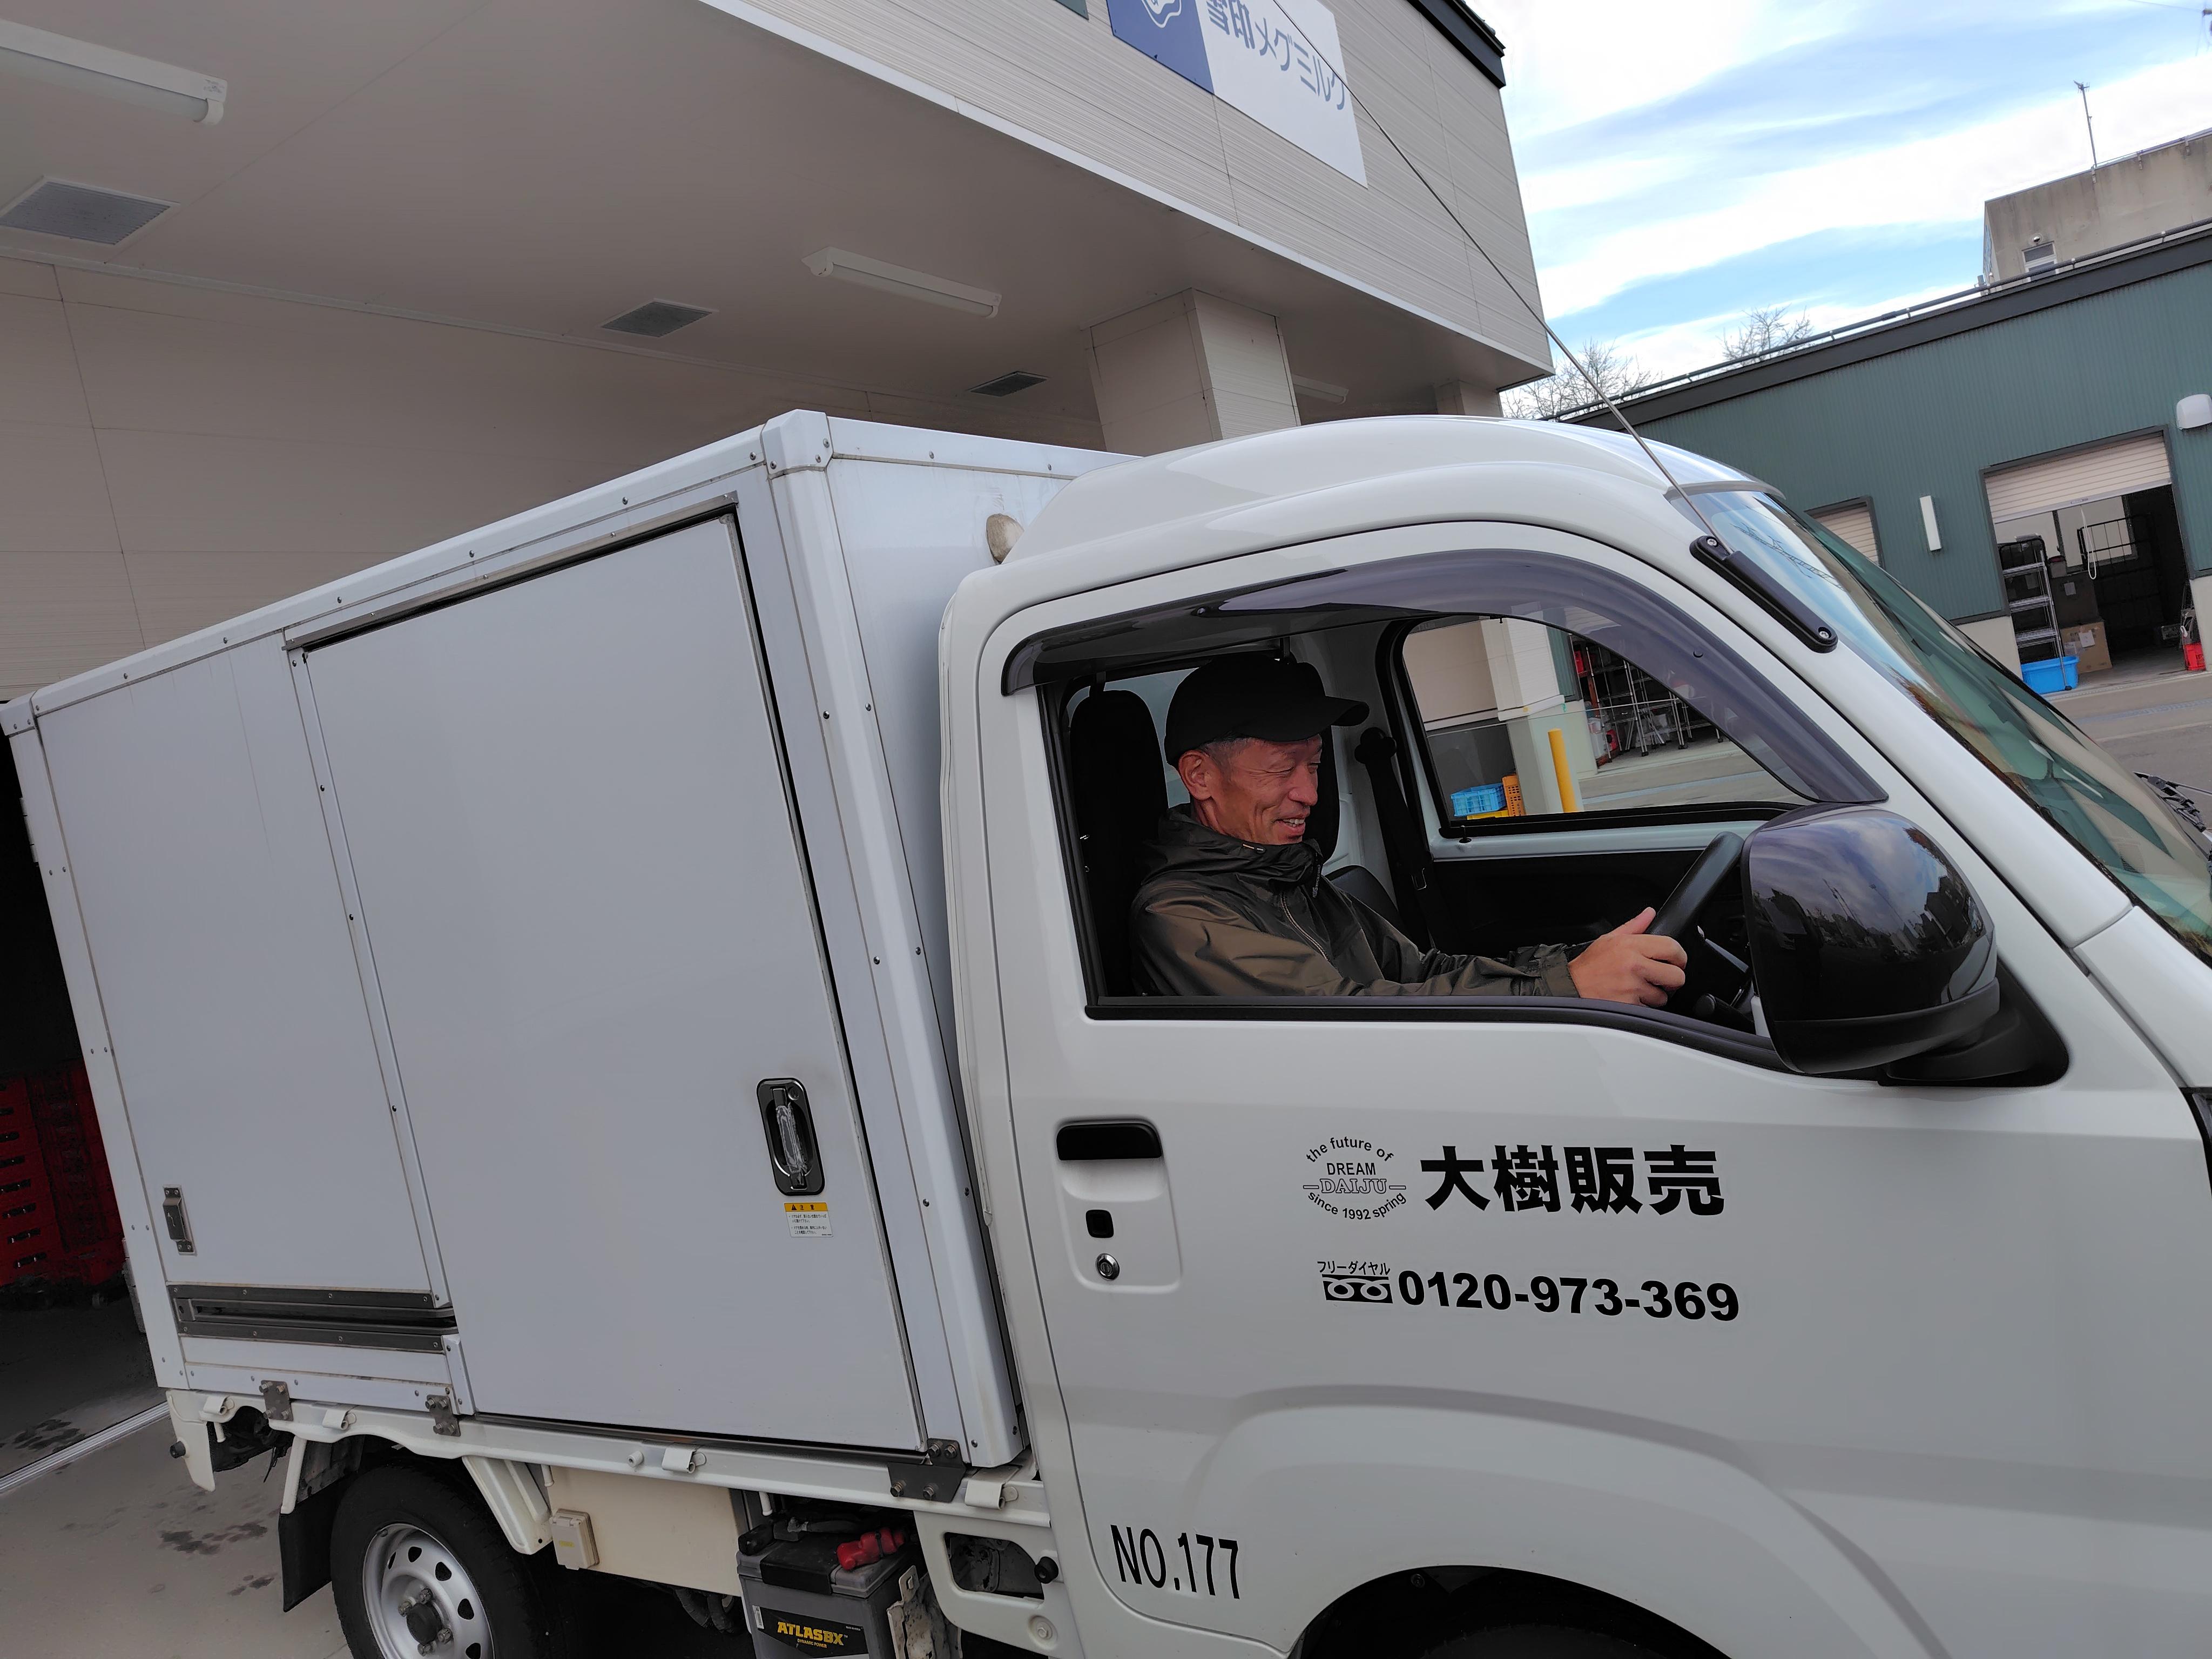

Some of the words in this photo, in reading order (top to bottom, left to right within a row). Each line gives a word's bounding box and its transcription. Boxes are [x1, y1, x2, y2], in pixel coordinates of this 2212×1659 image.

[1306, 1144, 1328, 1163] the
[1330, 1136, 1372, 1151] future
[1377, 1149, 1394, 1162] of
[1327, 1163, 1376, 1175] DREAM
[1420, 1144, 1725, 1216] 大樹販売
[1319, 1178, 1387, 1193] DAIJU
[1308, 1192, 1338, 1215] since
[1343, 1208, 1371, 1220] 1992
[1372, 1192, 1406, 1218] spring
[1317, 1260, 1391, 1276] フリーダイヤル
[1398, 1271, 1739, 1321] 0120-973-369
[1110, 1525, 1240, 1599] NO.177
[777, 1621, 844, 1646] ATLASBX
